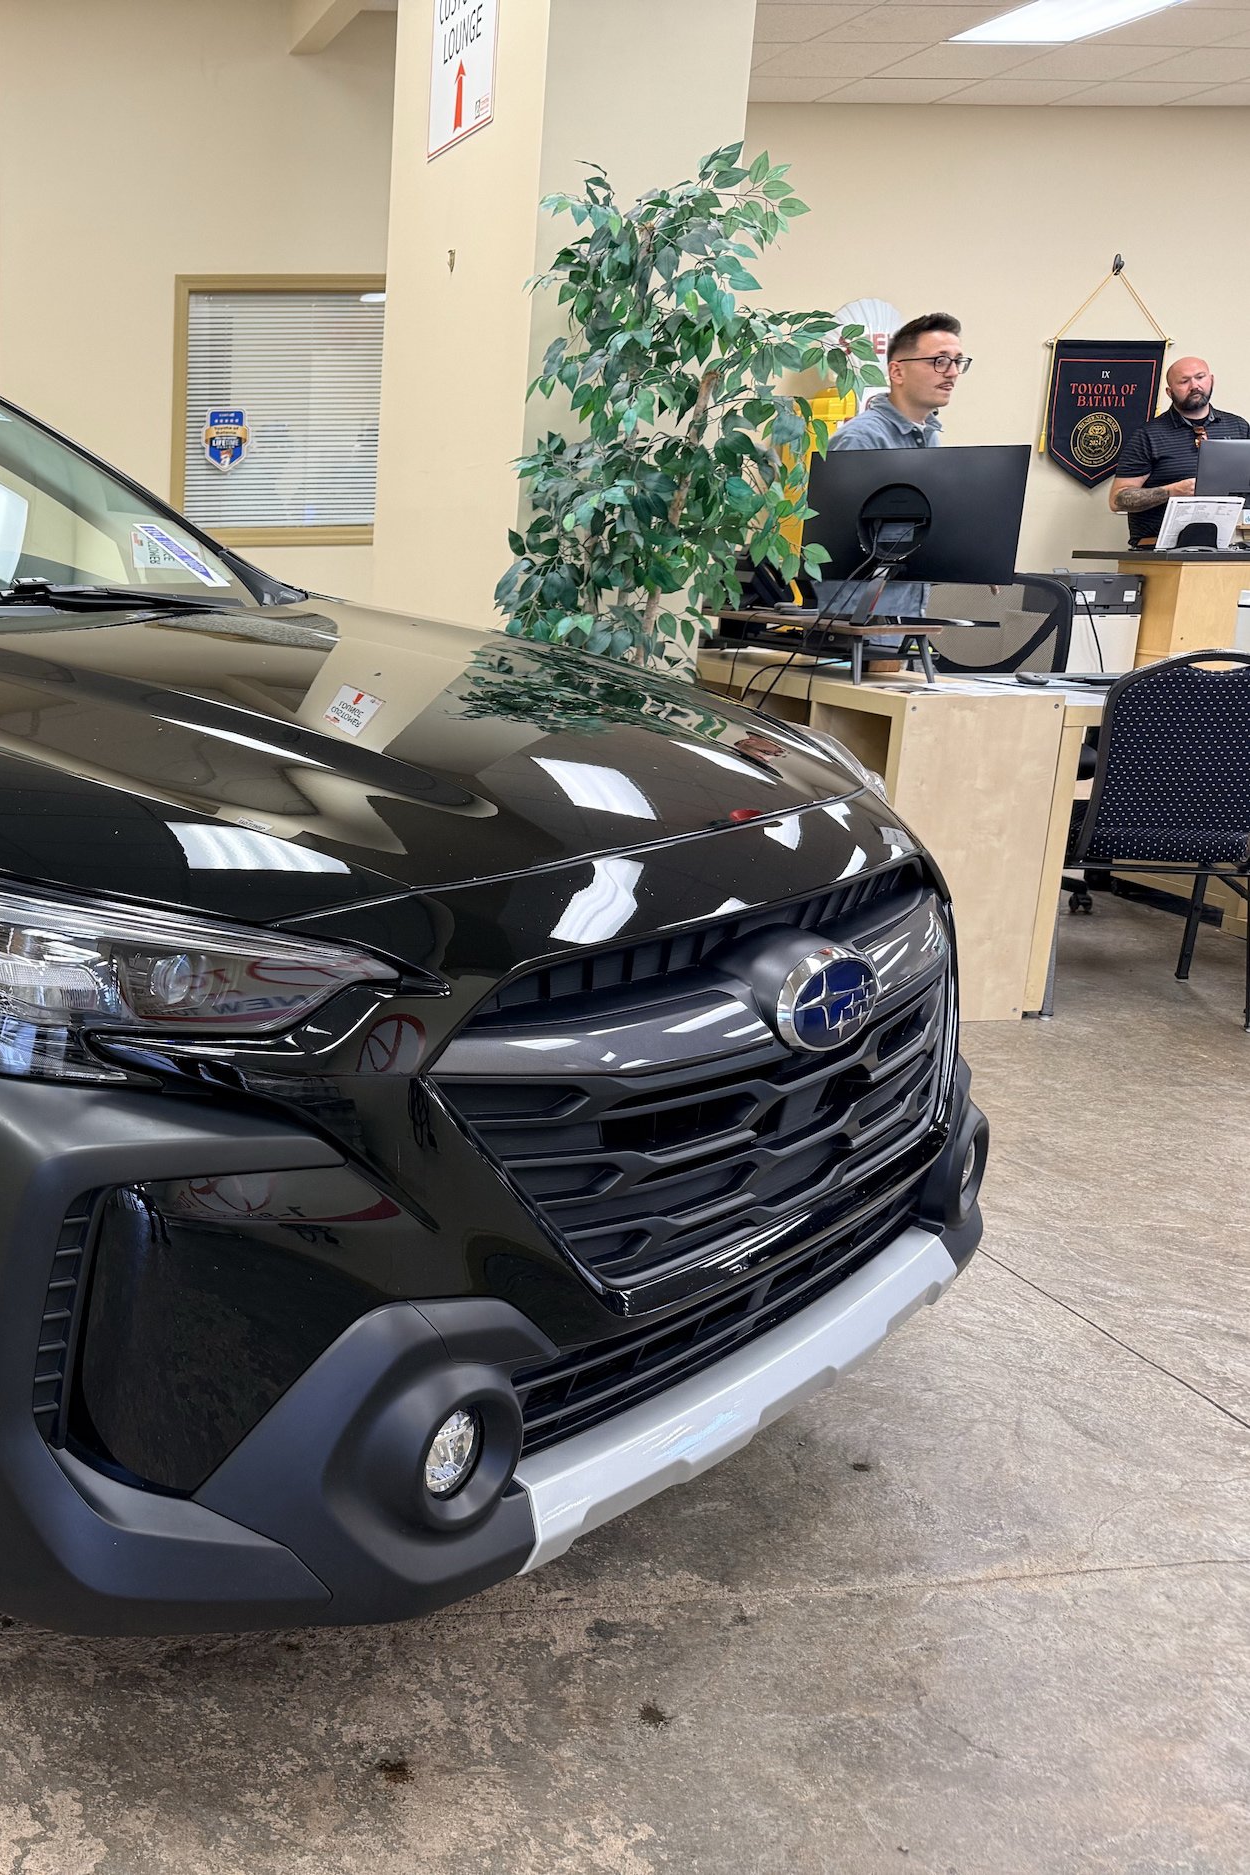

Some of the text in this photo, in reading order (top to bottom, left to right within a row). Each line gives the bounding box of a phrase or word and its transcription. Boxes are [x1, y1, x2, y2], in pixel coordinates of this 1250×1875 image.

[443, 3, 483, 65] LOUNGE
[1102, 370, 1110, 379] IX
[1070, 383, 1137, 395] TOYOTA OF
[1077, 396, 1125, 407] BATAVIA
